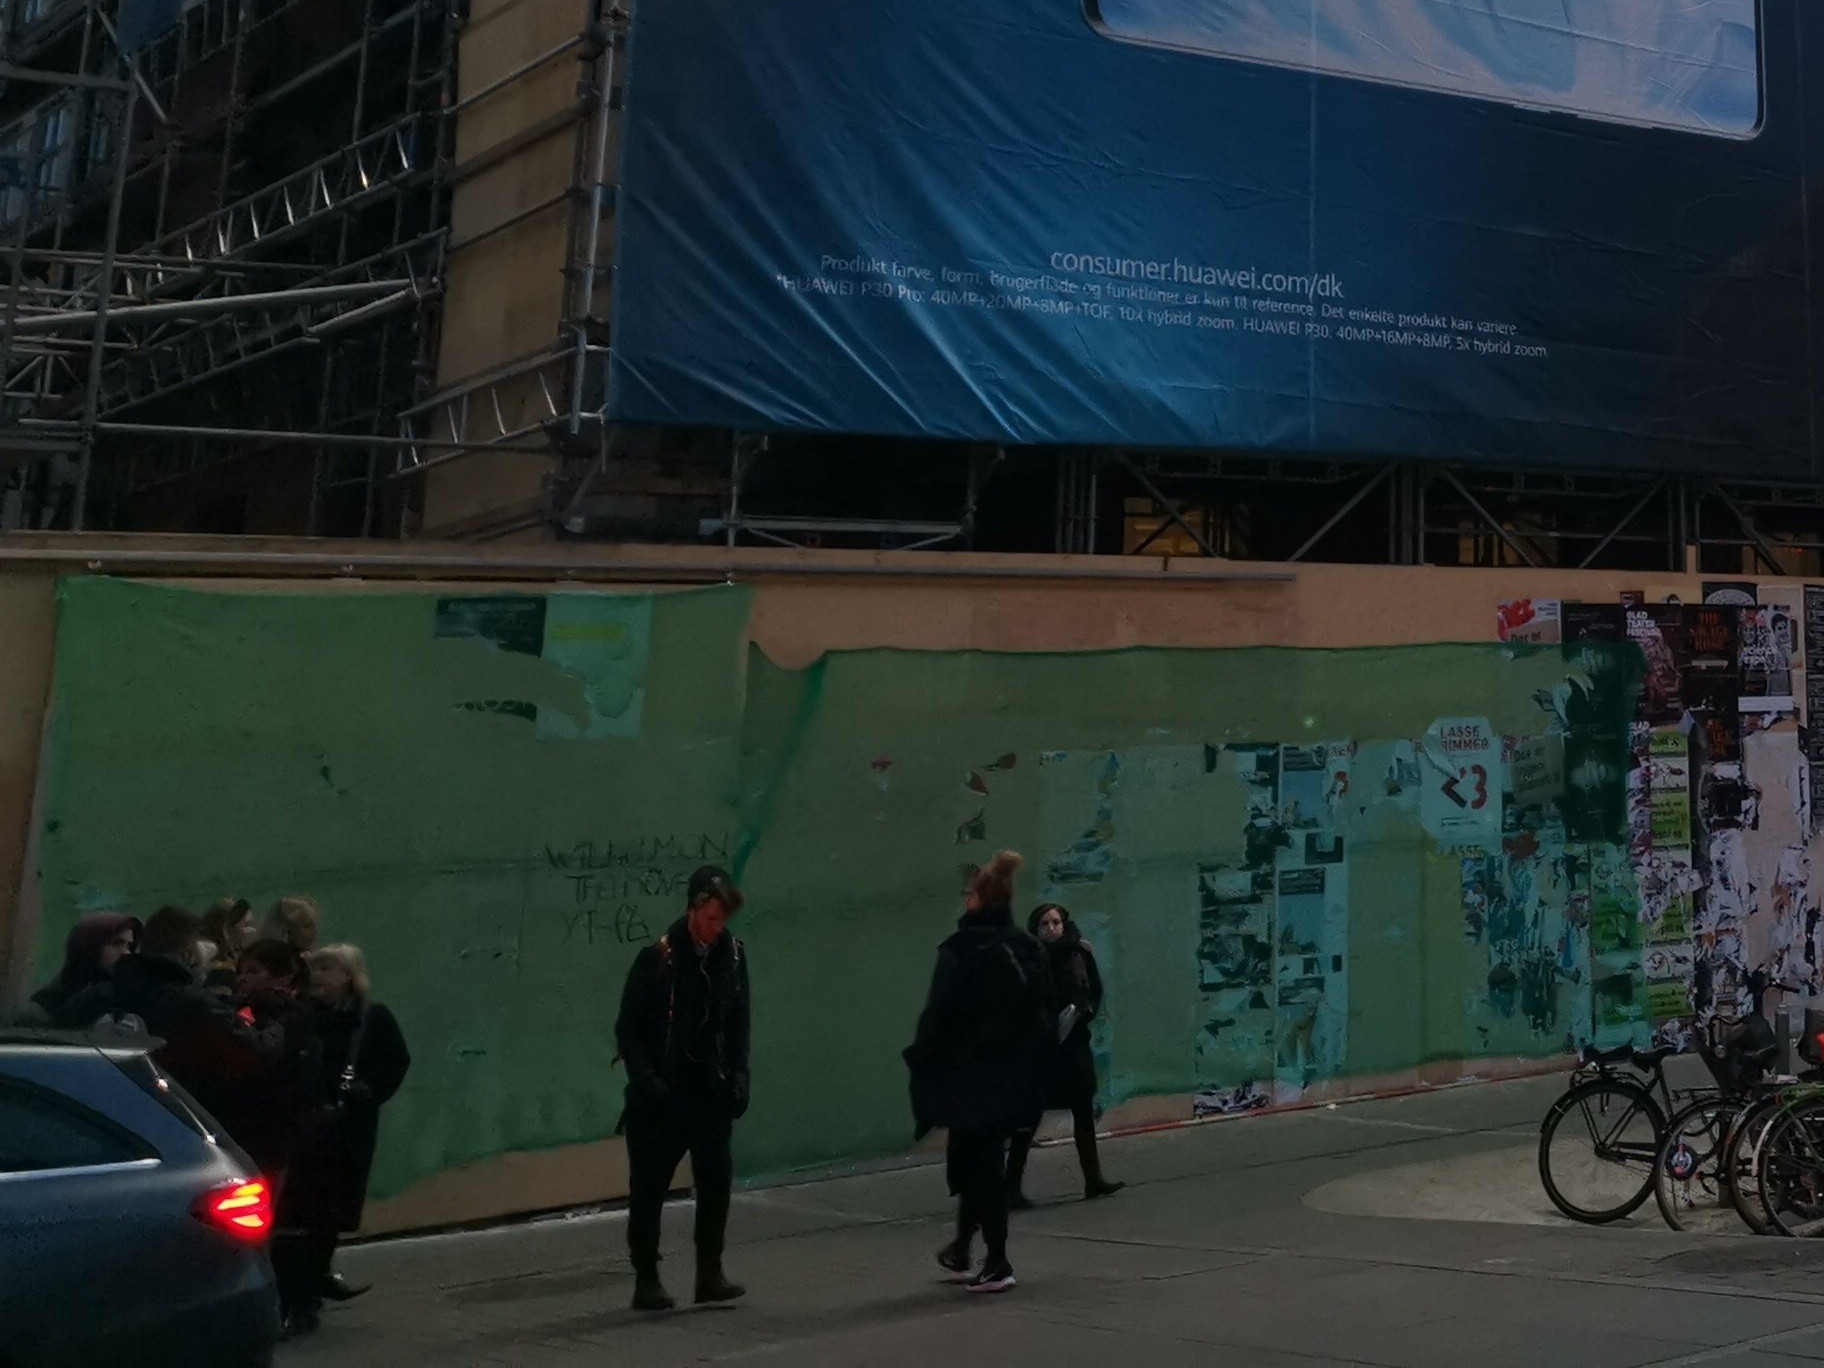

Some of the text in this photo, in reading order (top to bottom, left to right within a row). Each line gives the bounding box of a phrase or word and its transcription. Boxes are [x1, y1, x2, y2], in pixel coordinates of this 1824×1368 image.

[820, 254, 887, 275] Produkt
[1320, 301, 1345, 320] Det
[1398, 308, 1448, 331] produkt
[1449, 314, 1474, 331] kan
[1049, 250, 1347, 302] consumer.huawei.com/dk
[1243, 316, 1301, 337] HUAWEI
[1474, 338, 1512, 358] hybrid
